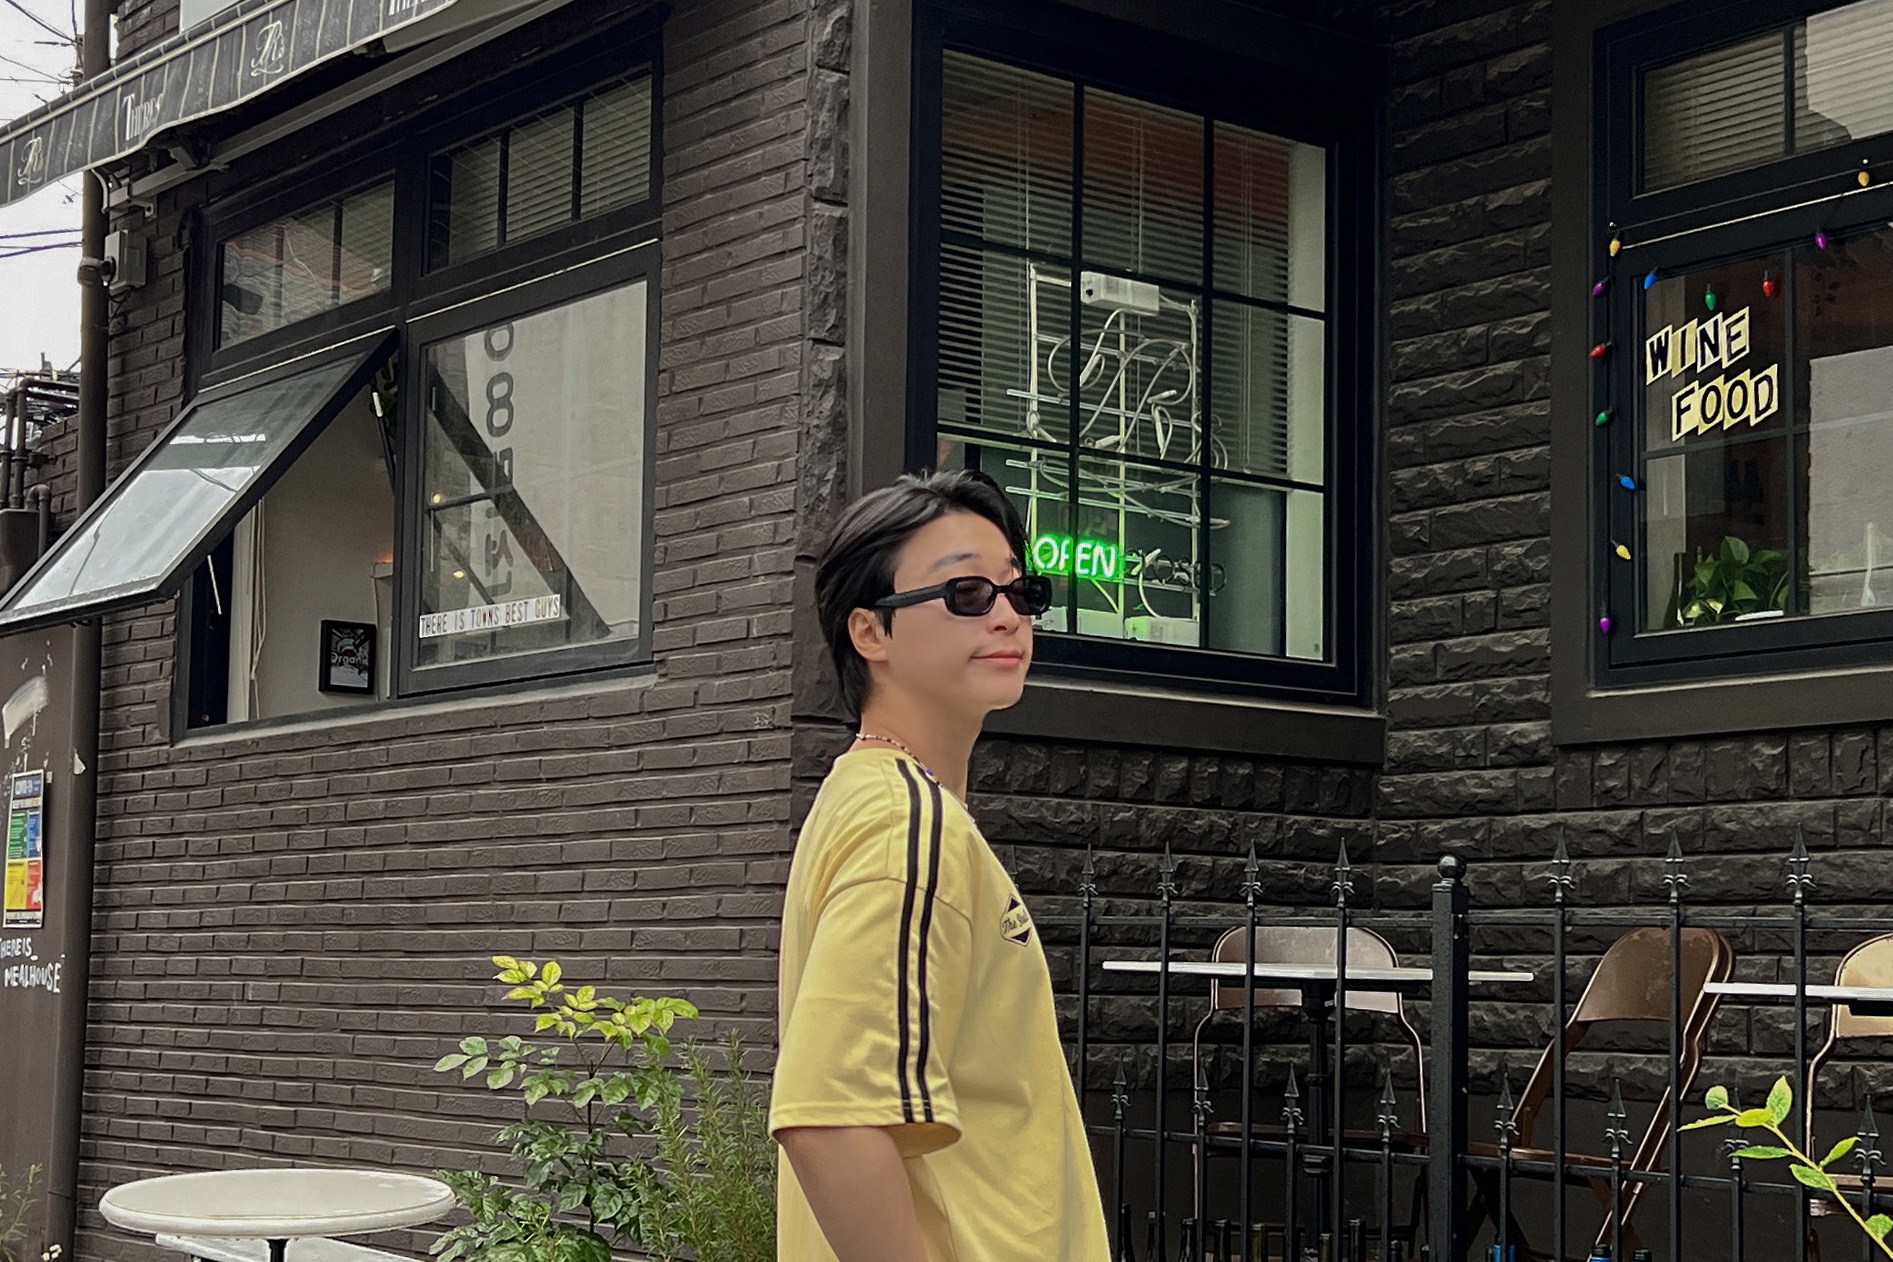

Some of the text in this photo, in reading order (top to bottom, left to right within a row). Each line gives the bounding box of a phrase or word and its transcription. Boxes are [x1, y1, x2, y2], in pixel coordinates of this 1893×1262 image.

[1649, 312, 1748, 378] WINE
[1676, 374, 1774, 435] FOOD
[1033, 537, 1117, 578] OPEN
[421, 613, 447, 636] THERE
[454, 611, 465, 631] IS
[505, 600, 529, 624] BEST
[535, 596, 560, 619] GUYS
